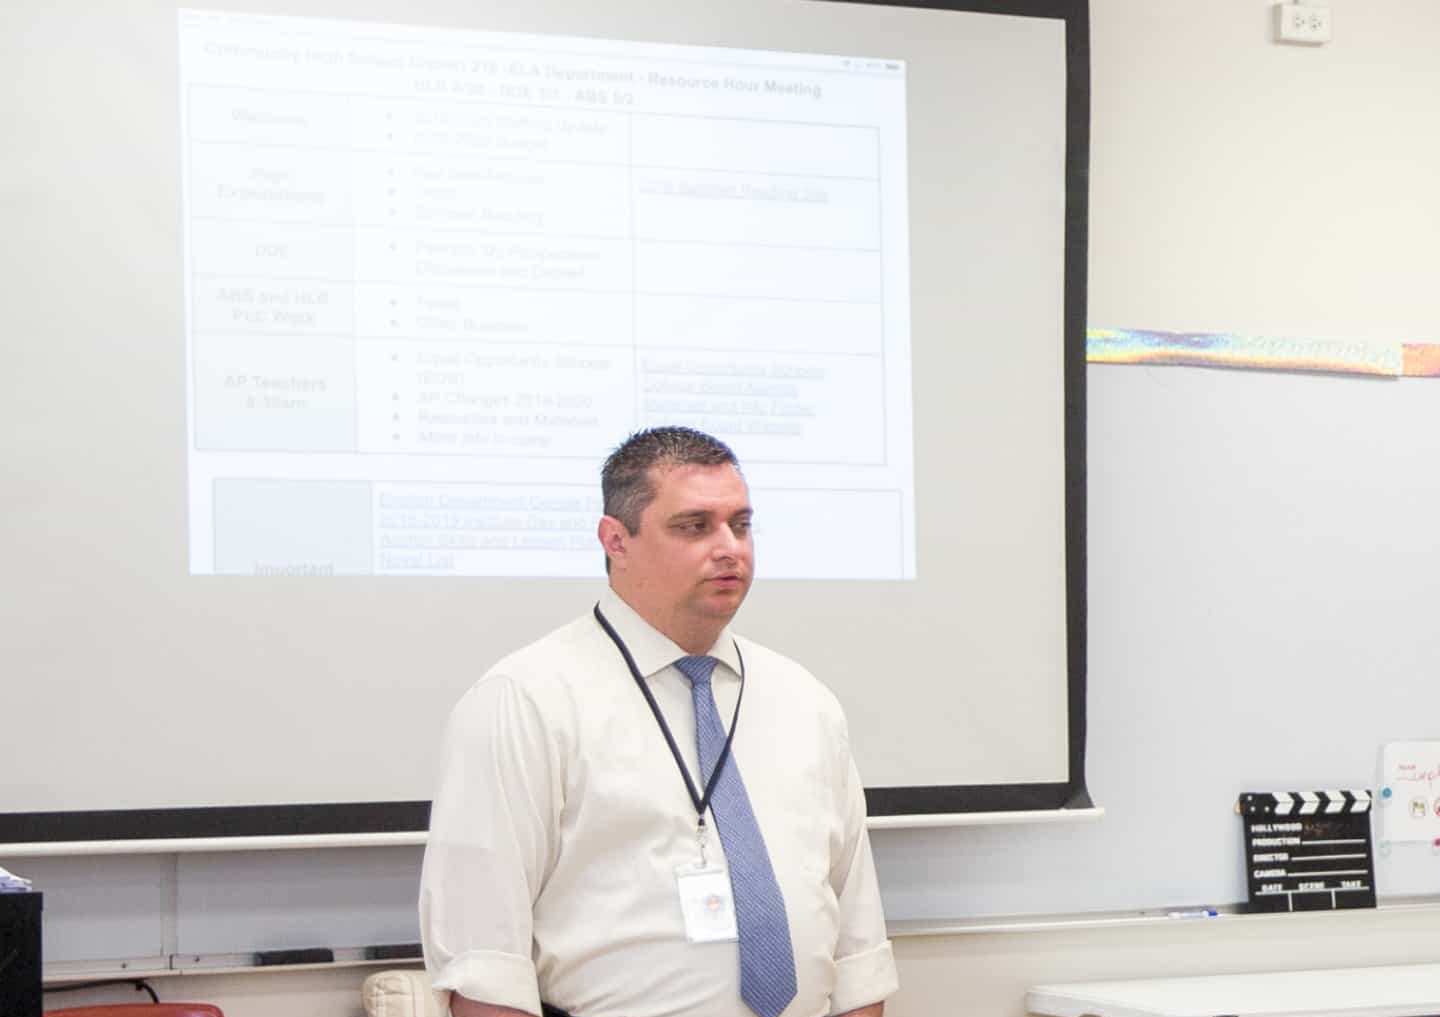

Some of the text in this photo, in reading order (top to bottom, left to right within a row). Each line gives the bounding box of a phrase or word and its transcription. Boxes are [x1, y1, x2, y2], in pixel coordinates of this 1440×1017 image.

[647, 71, 720, 91] Resource
[723, 76, 760, 93] Hour
[763, 79, 823, 100] Meeting
[1251, 823, 1303, 833] HOLLYWOOD
